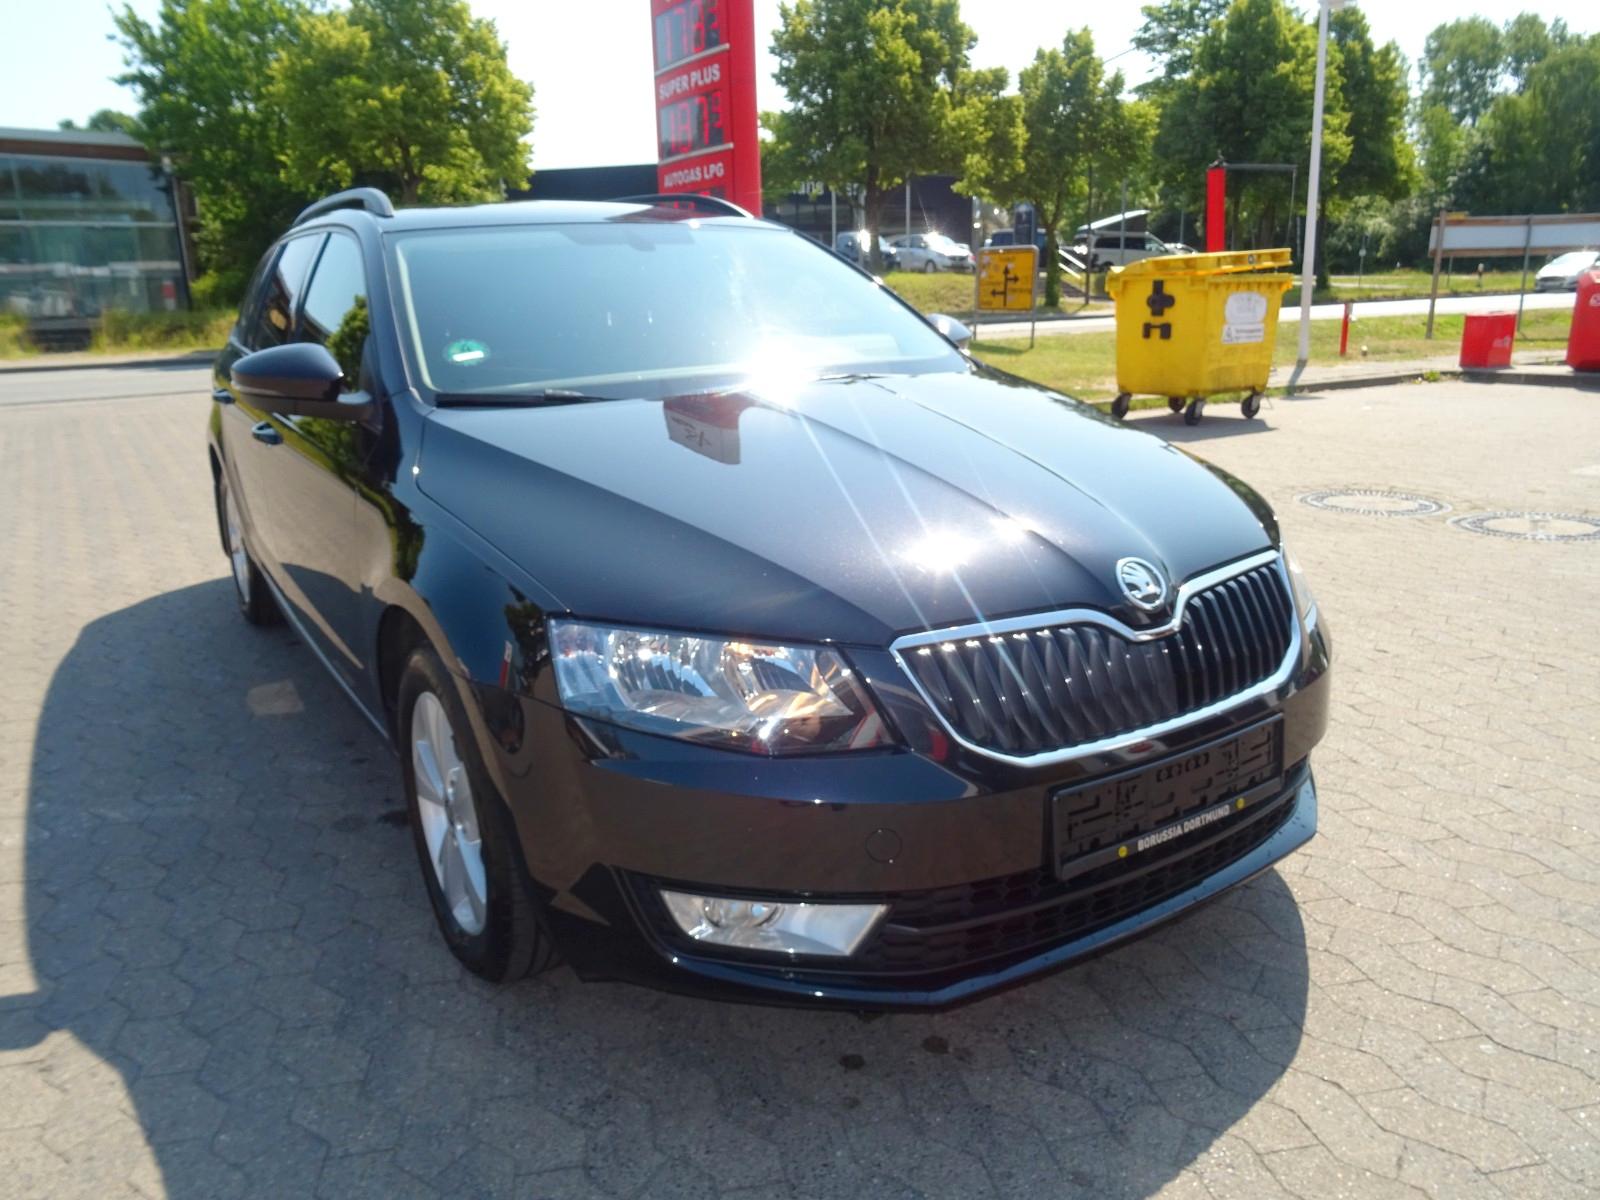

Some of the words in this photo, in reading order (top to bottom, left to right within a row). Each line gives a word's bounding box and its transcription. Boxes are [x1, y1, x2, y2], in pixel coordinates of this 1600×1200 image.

[659, 75, 689, 99] SUPER
[690, 63, 721, 89] PLUS
[663, 165, 702, 188] AUTOGAS
[703, 161, 725, 180] LPG
[1137, 824, 1183, 851] BORUSSIA
[1183, 804, 1230, 833] DORTMUND
